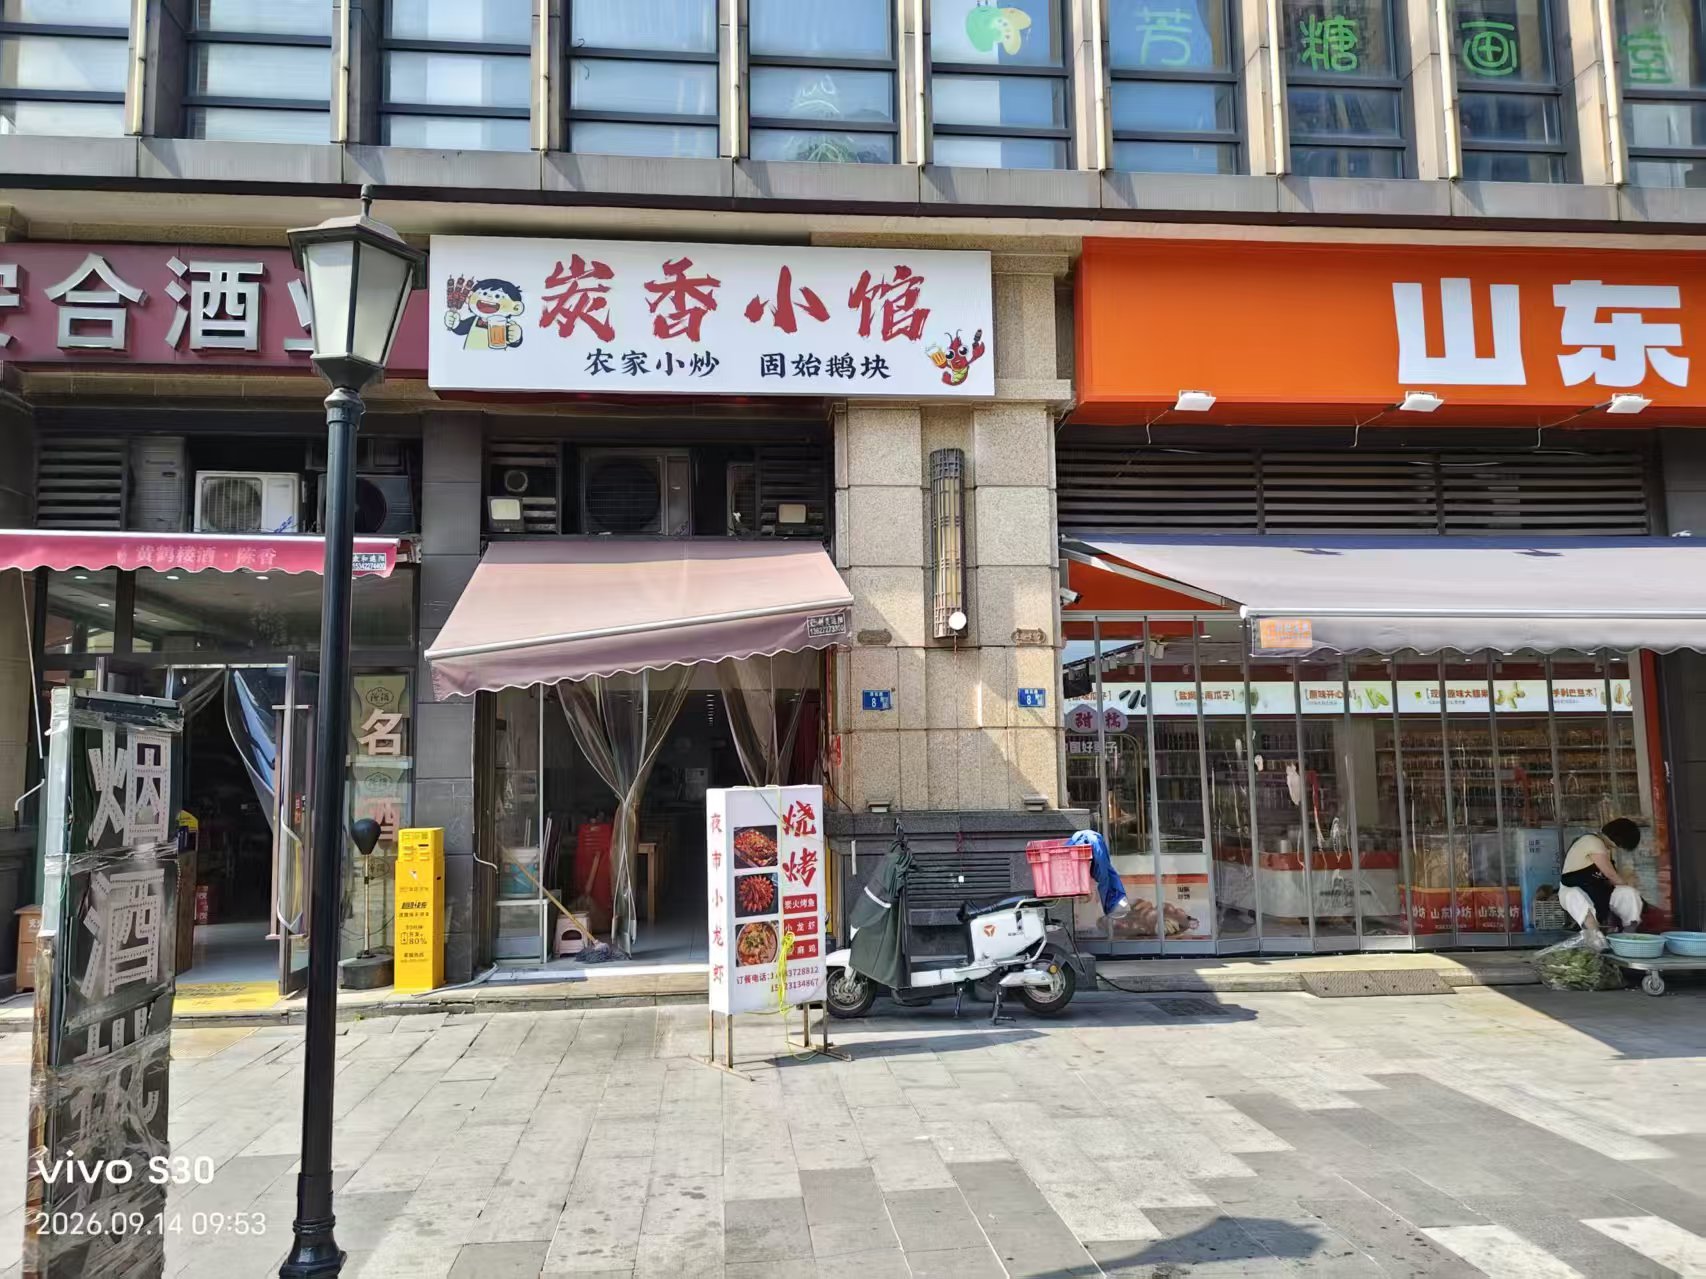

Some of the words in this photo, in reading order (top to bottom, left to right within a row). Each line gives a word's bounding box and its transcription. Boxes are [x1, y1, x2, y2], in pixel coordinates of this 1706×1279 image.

[0, 252, 313, 351] 合酒
[539, 253, 931, 343] 炭香小馆
[1392, 277, 1690, 387] 山东
[586, 347, 721, 378] 农家小炒
[759, 351, 892, 381] 固始鹅块
[782, 799, 818, 888] 烧烤
[709, 812, 725, 985] 夜市小龙虾
[787, 944, 817, 956] 麻鸡
